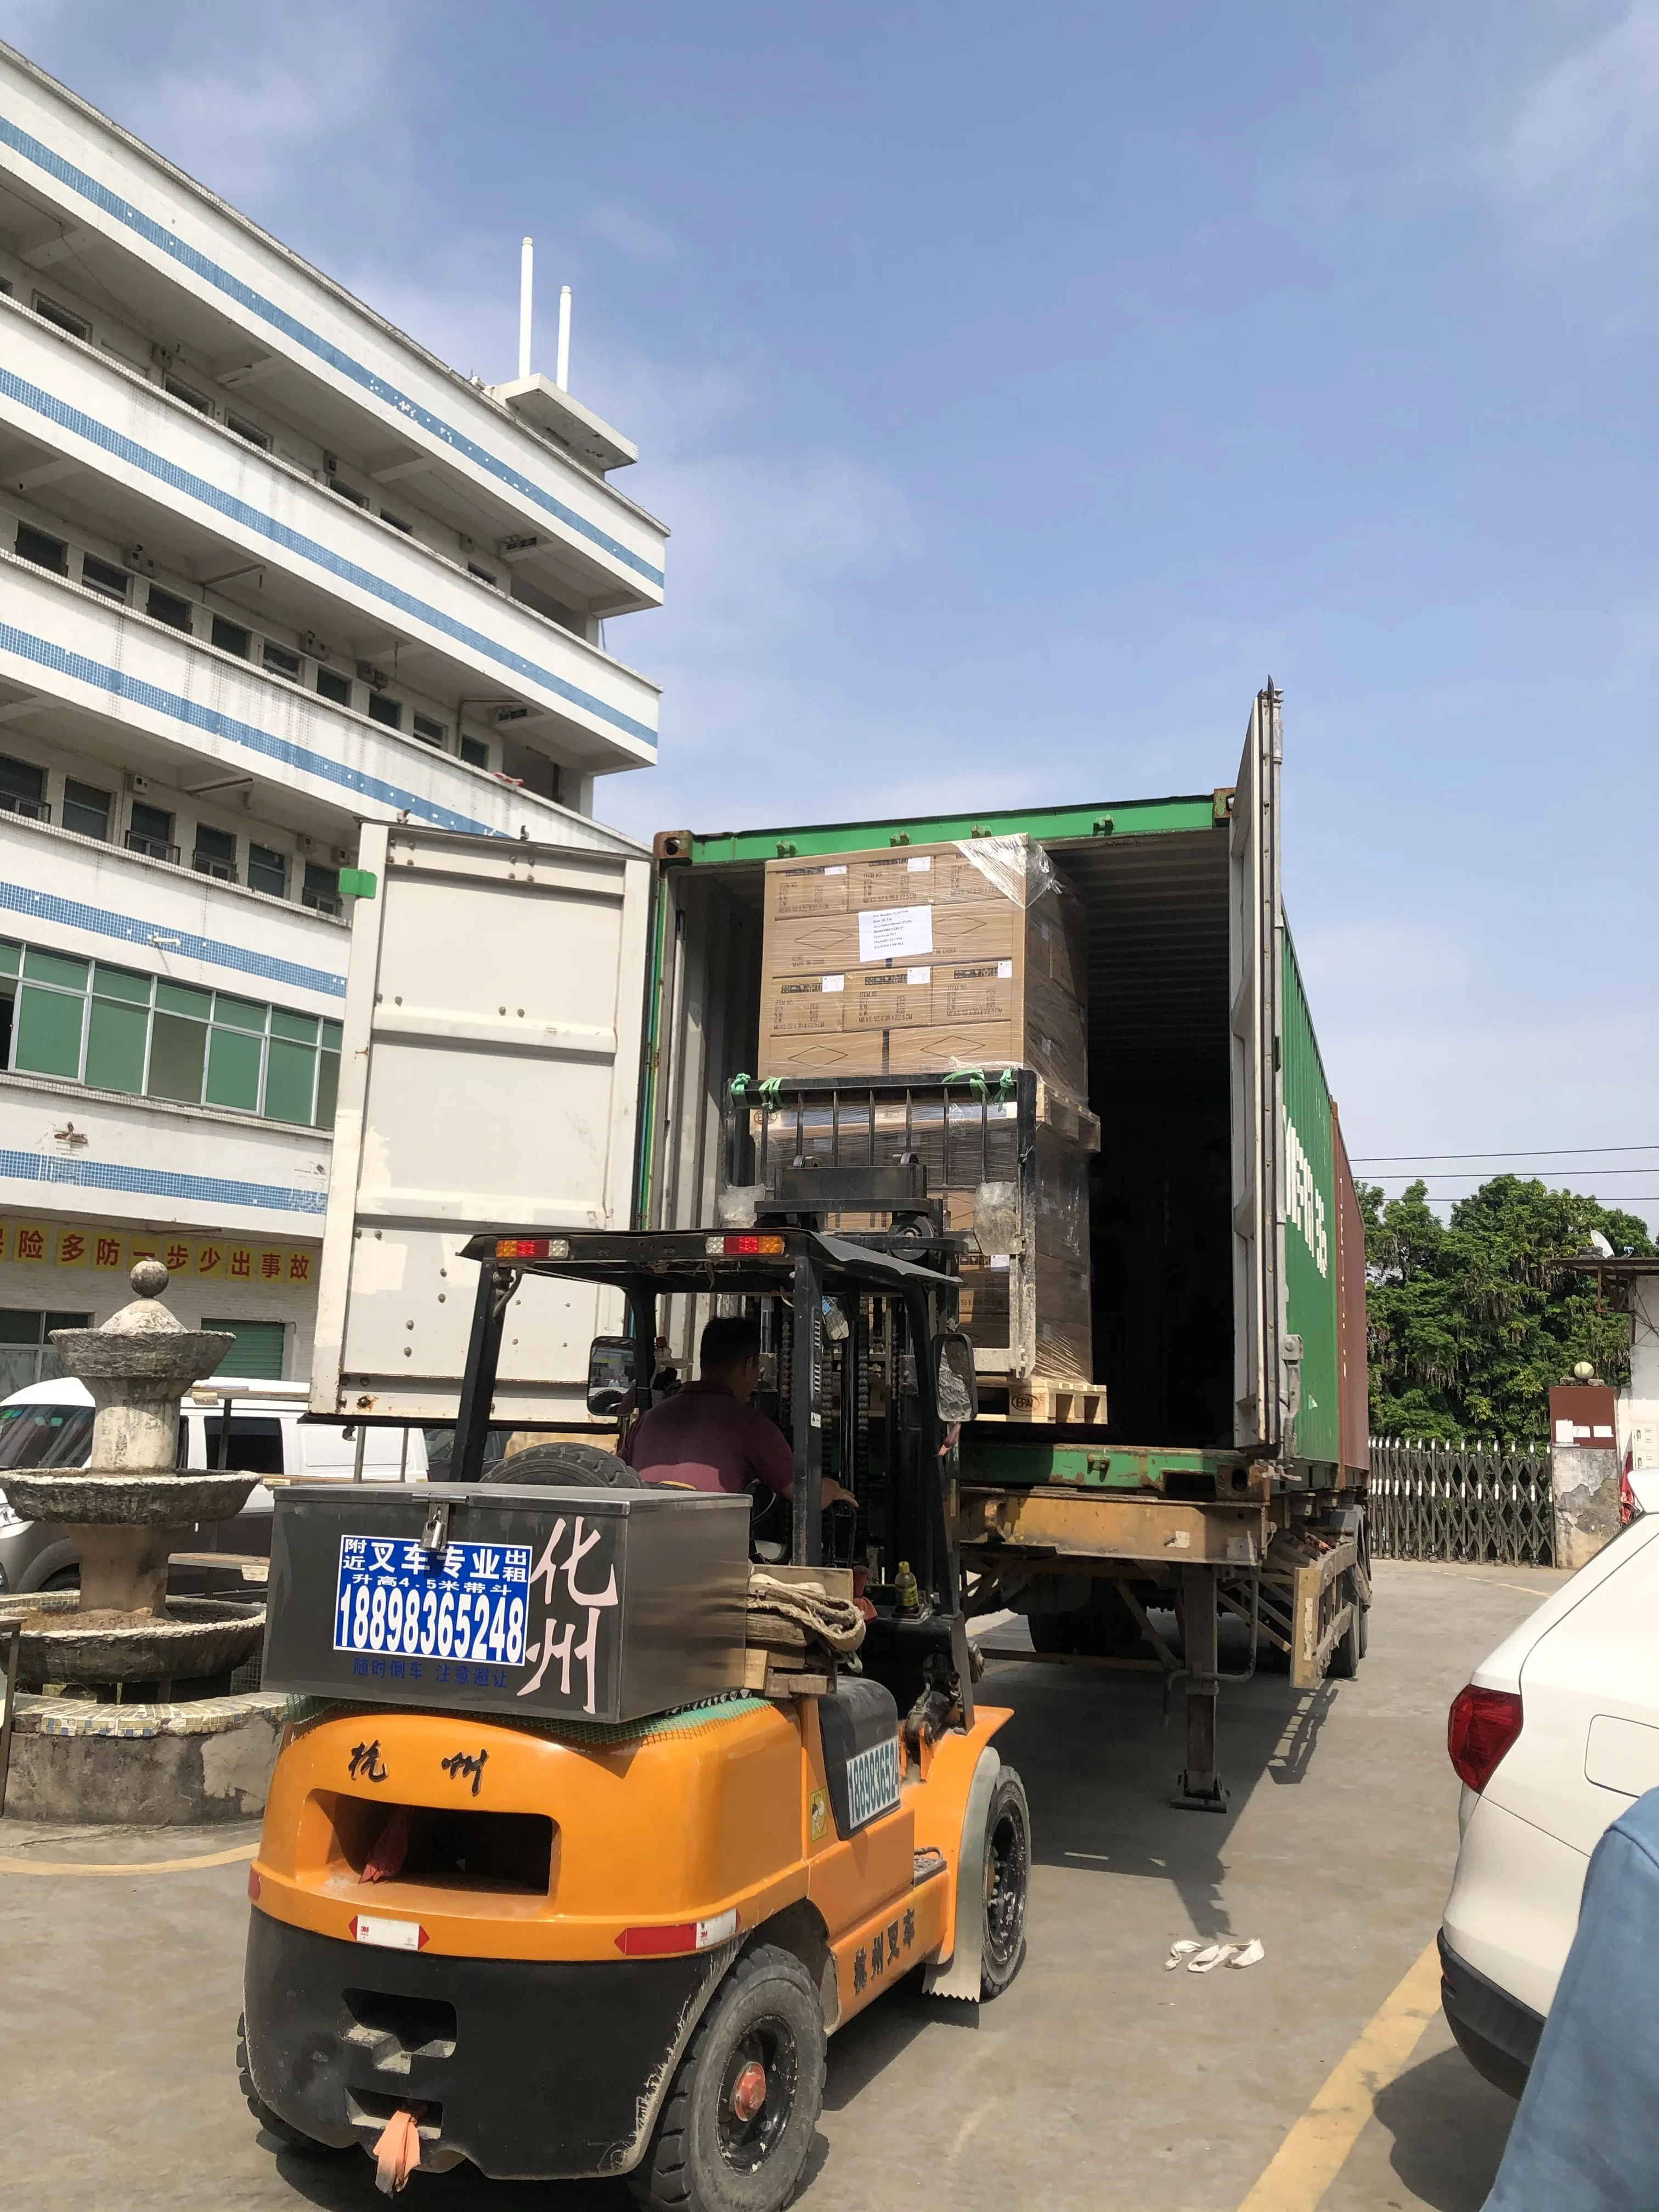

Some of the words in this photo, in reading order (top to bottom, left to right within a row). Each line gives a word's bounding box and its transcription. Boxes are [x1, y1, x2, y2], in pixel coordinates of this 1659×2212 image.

[0, 1228, 309, 1279] 险多防一步少出事故
[343, 1539, 367, 1571] 附近
[368, 1542, 500, 1579] 叉车专业
[503, 1549, 527, 1583] 出租
[340, 1583, 524, 1663] 18898365248
[516, 1516, 618, 1715] 化州
[353, 1657, 423, 1680] 随时倒车
[436, 1663, 507, 1689] 注意避让
